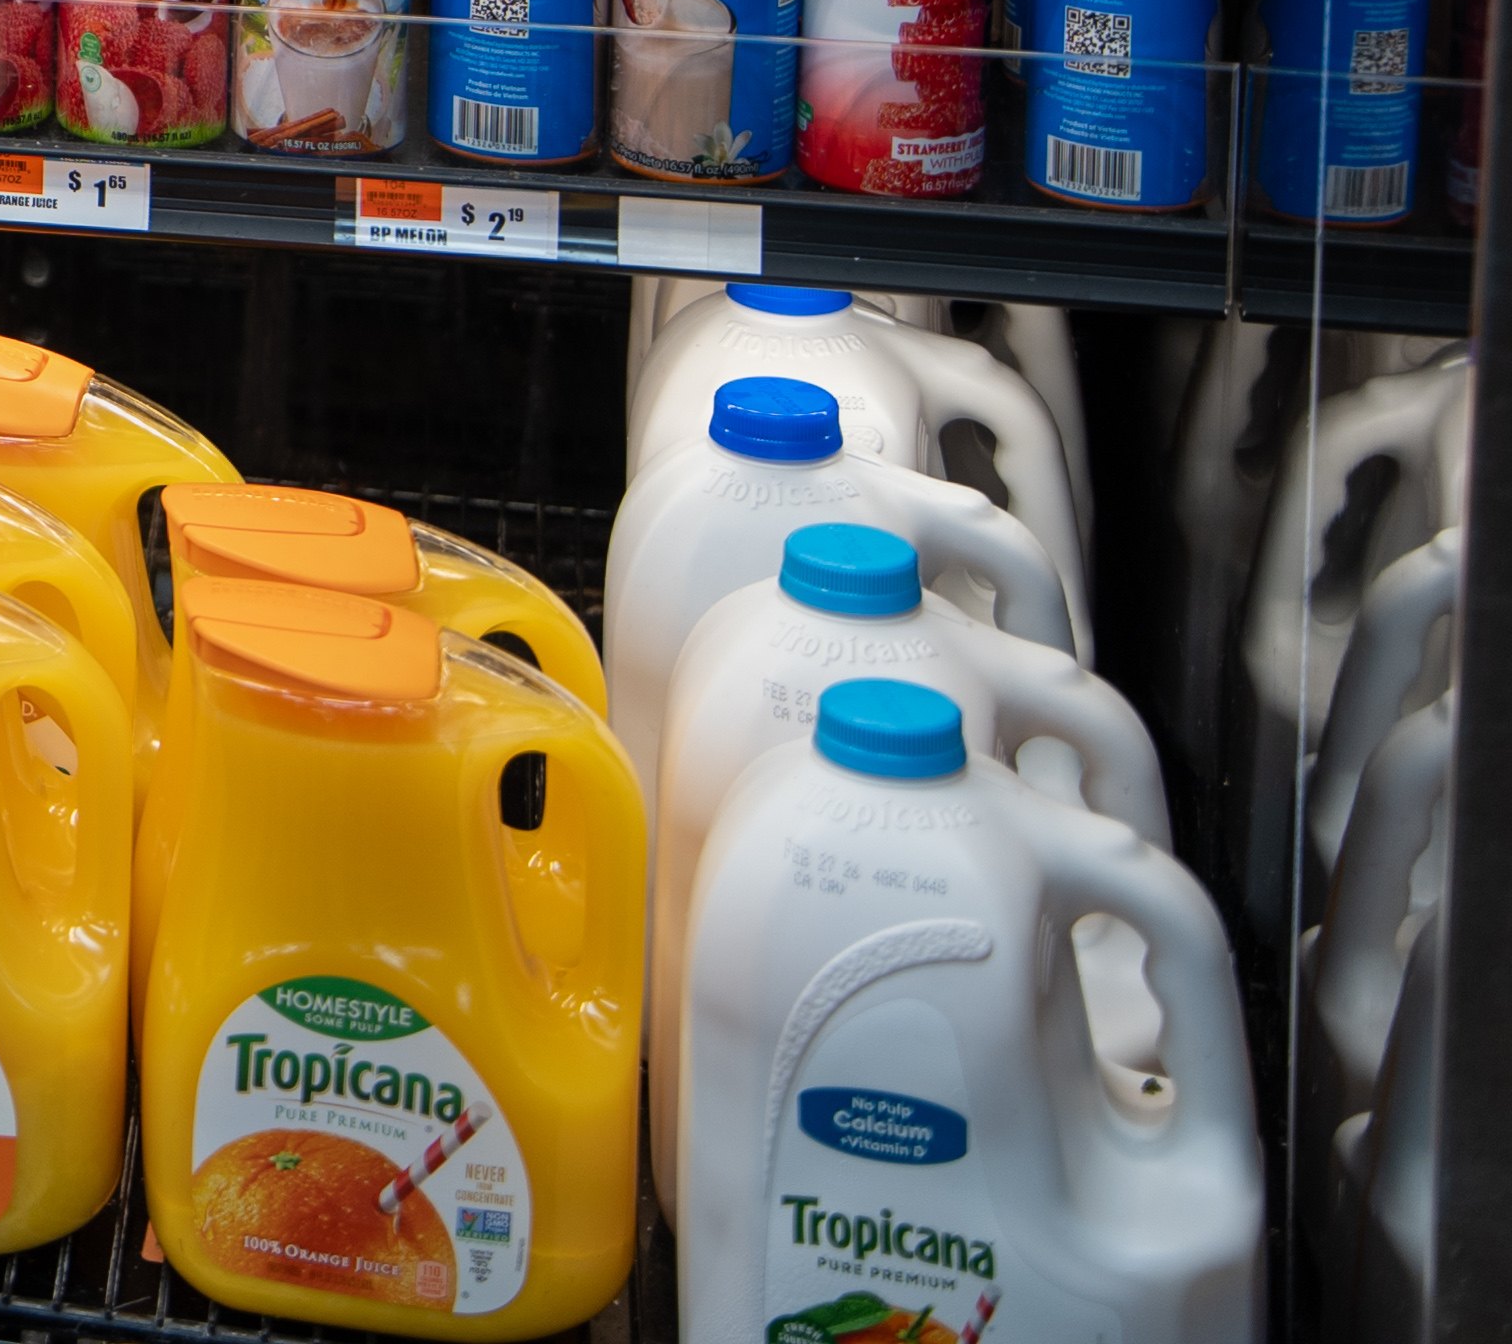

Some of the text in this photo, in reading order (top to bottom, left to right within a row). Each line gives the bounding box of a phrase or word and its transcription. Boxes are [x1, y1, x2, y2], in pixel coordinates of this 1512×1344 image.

[33, 196, 58, 210] JUICE
[371, 226, 447, 244] BP MELON
[276, 987, 413, 1028] HOMESTYLE
[782, 1195, 996, 1279] Tropicana
